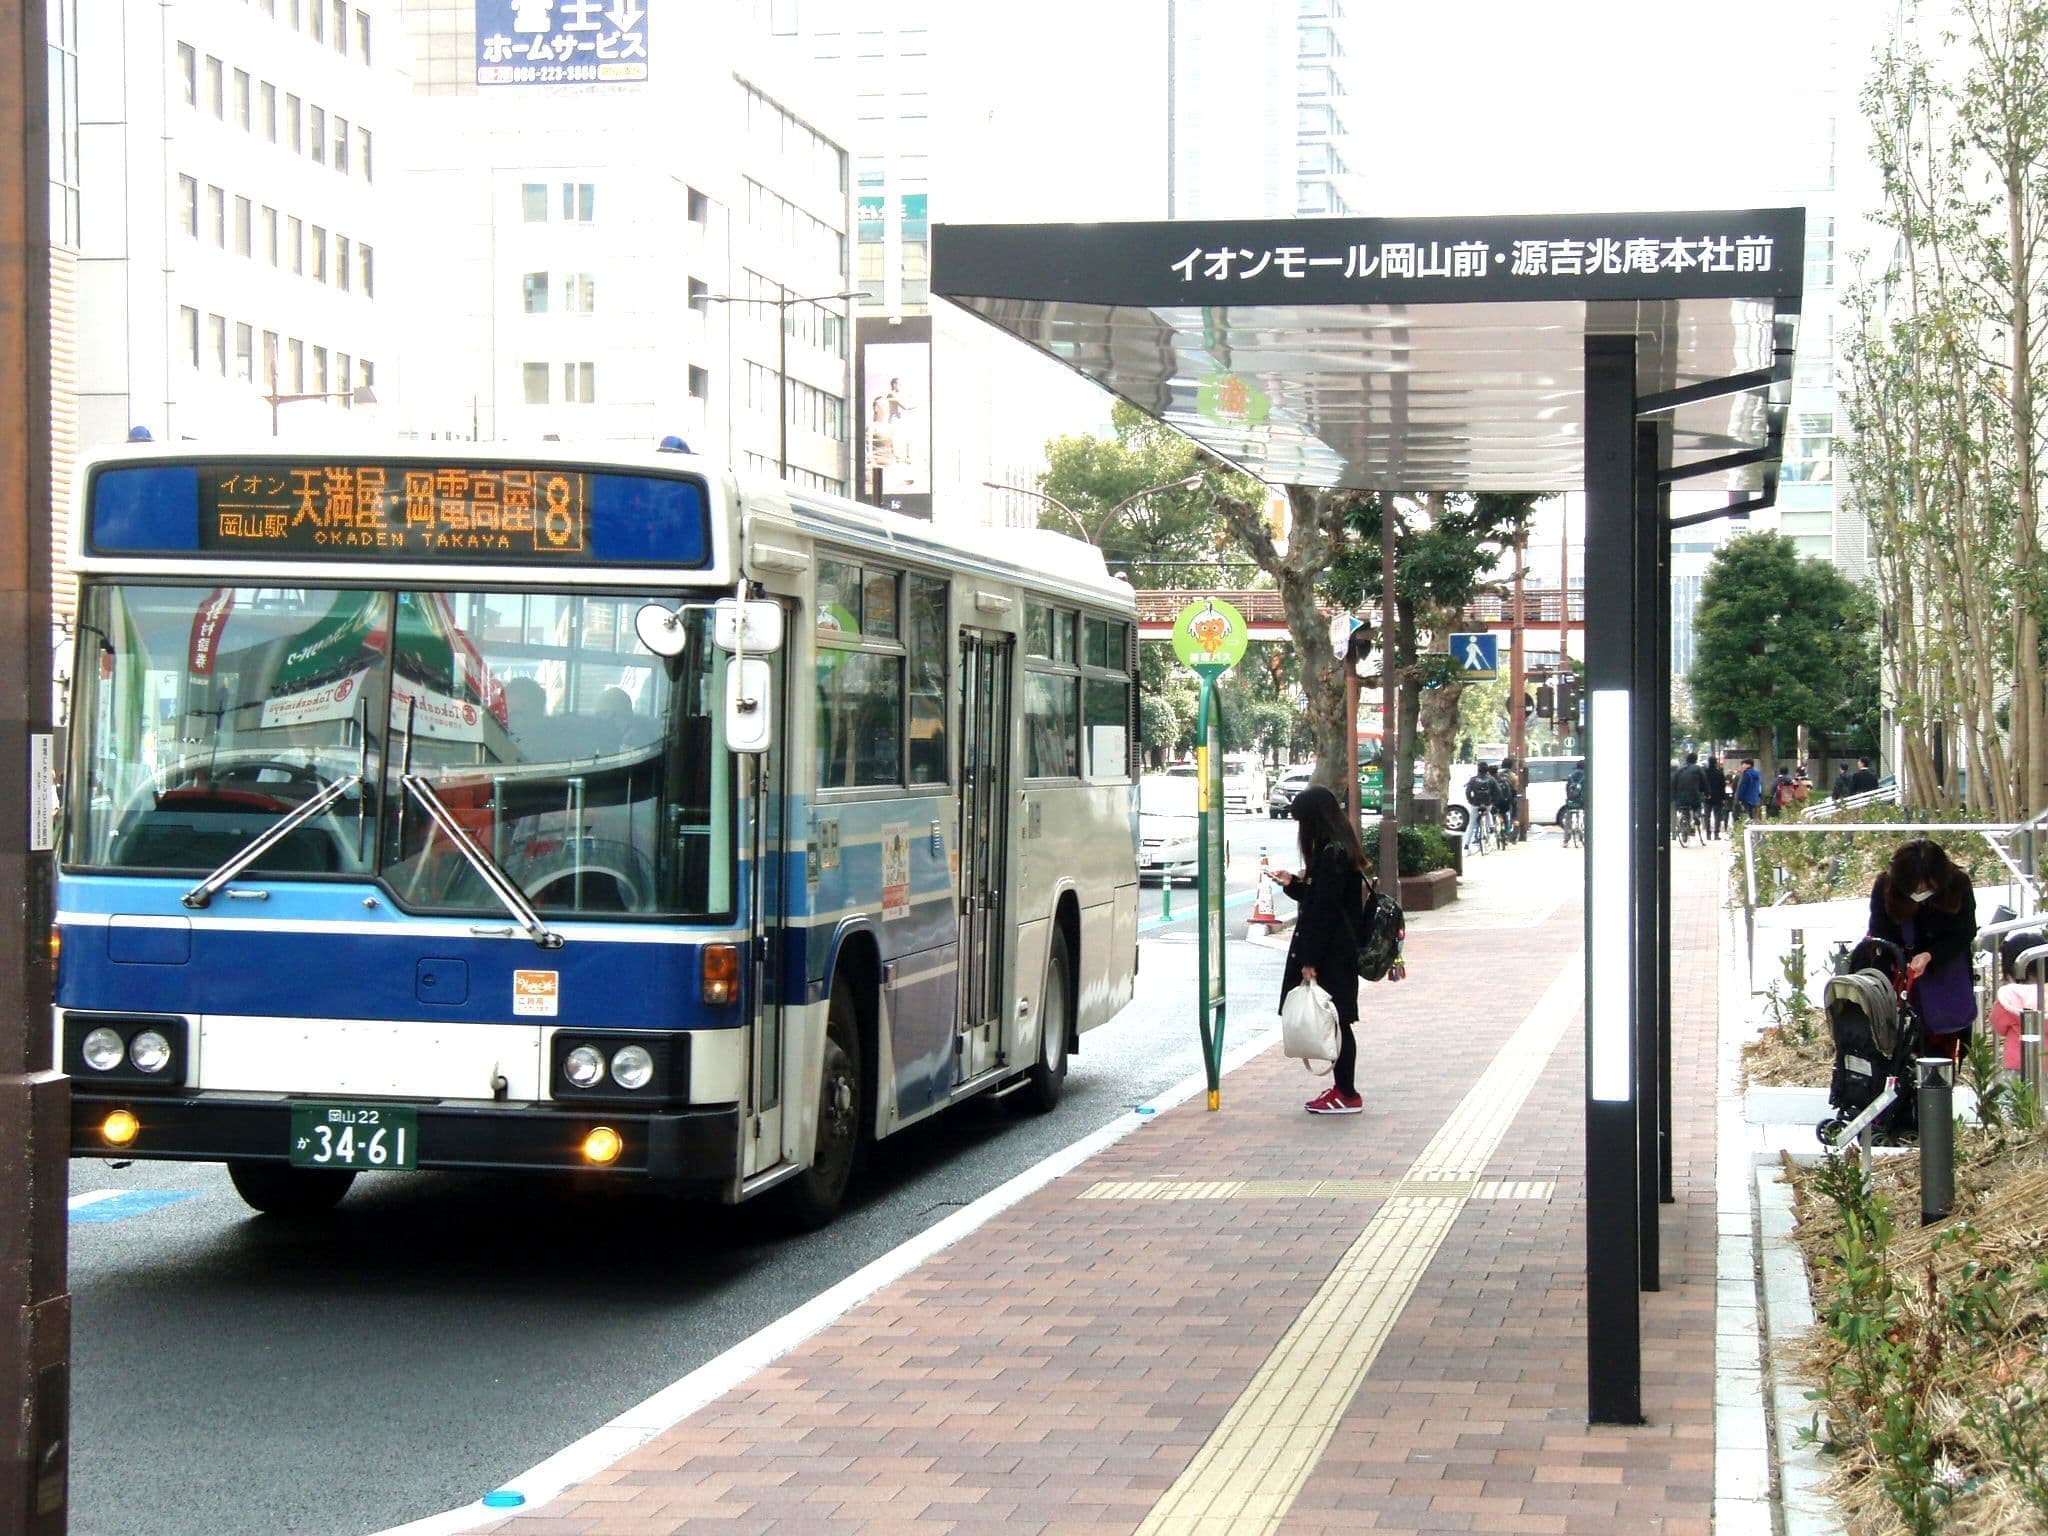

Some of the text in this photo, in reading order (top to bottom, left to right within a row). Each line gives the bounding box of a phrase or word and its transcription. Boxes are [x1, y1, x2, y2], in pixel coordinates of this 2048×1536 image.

[483, 31, 647, 63] ホームサービス
[1171, 235, 1774, 281] イオンモール岡山前・源吉兆庵本社前
[220, 475, 286, 494] イオン
[219, 513, 288, 537] 岡山駅
[546, 476, 573, 545] 8
[422, 533, 511, 549] TAKAYA
[297, 1125, 405, 1165] か 34-61
